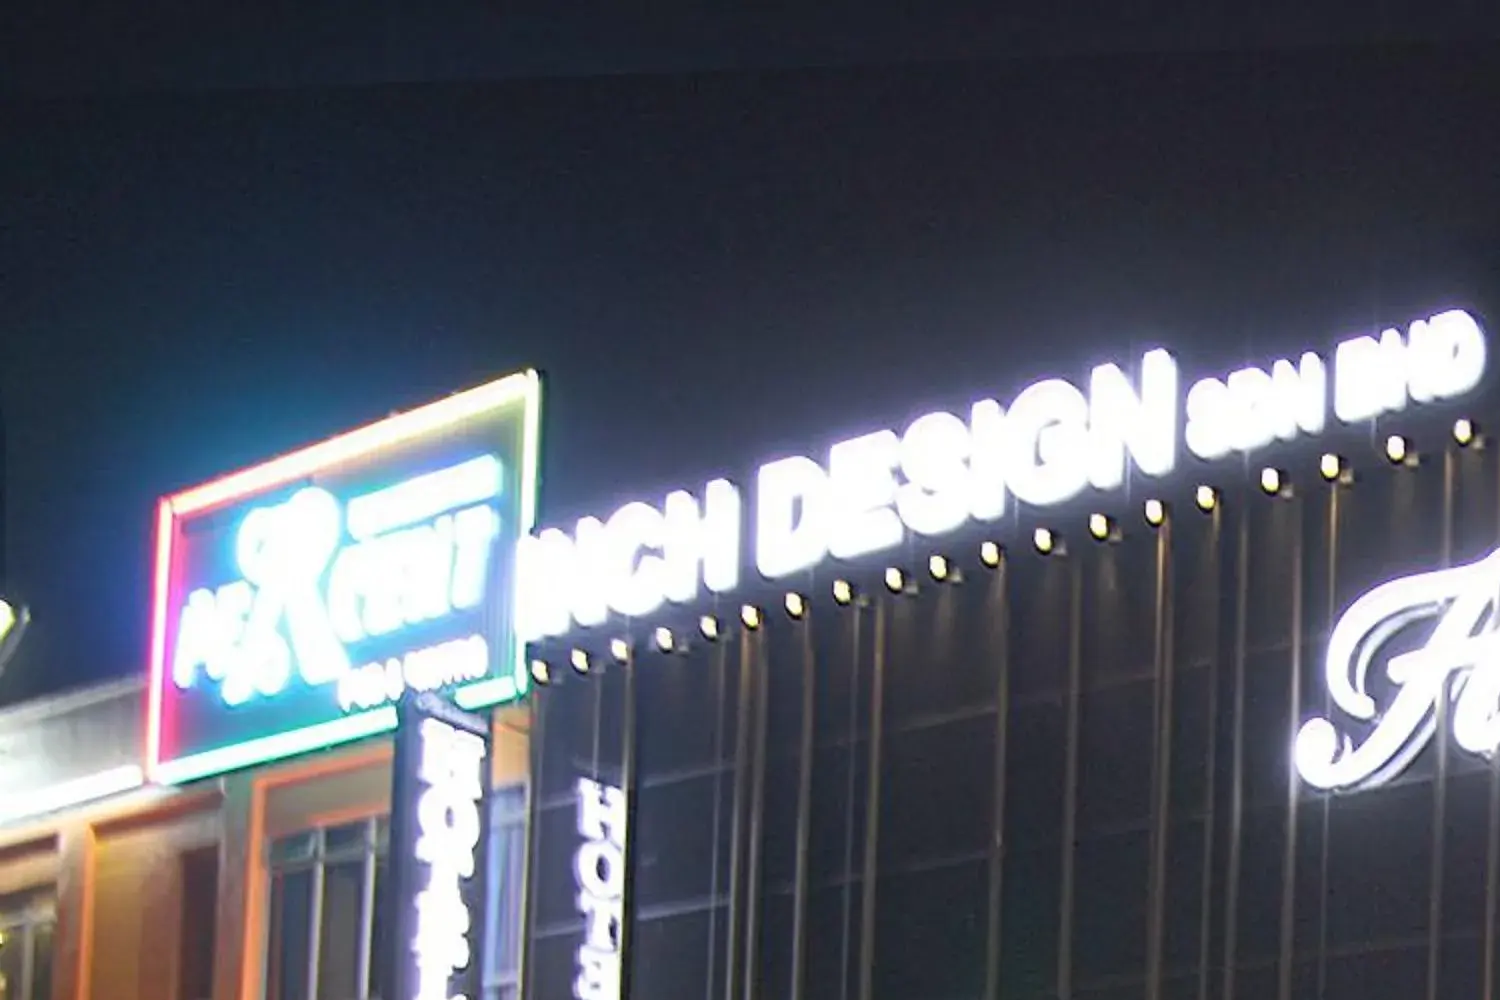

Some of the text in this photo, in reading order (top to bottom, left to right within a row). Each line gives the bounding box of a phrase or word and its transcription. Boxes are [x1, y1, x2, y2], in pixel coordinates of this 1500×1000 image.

[516, 480, 737, 638] INCH
[758, 351, 1174, 576] DESIGN
[1187, 353, 1323, 456] SDN
[1336, 309, 1483, 420] BHD
